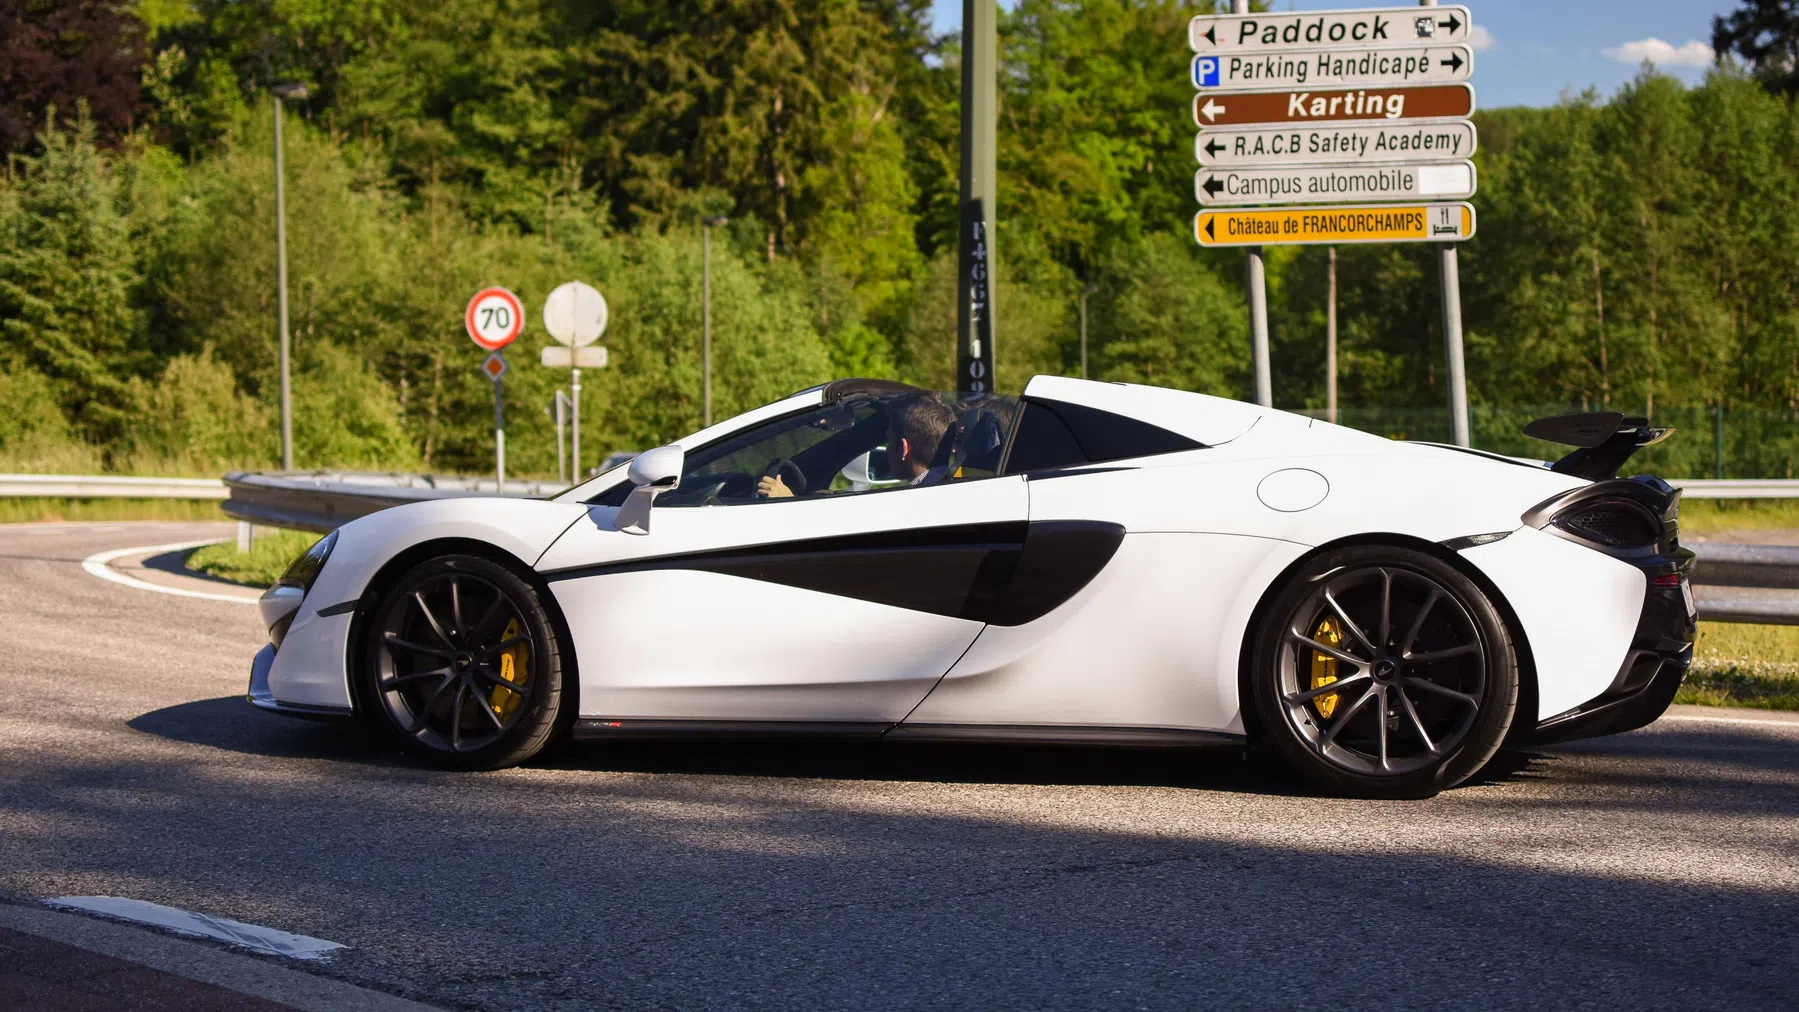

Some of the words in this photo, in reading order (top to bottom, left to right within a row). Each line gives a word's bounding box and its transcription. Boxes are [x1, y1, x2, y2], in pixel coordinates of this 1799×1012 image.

[1238, 15, 1389, 45] Paddock
[1199, 60, 1216, 84] P
[1229, 56, 1308, 83] Parking
[1317, 49, 1429, 80] Handicapé
[1287, 91, 1405, 119] Karting
[1234, 134, 1301, 156] R.A.C.B
[1308, 132, 1369, 157] Safety
[1375, 130, 1462, 154] Academy
[1227, 173, 1302, 198] Campus
[1308, 169, 1413, 194] automobile
[1228, 217, 1279, 236] Château
[1283, 216, 1299, 234] de
[1303, 213, 1423, 233] FRANCORCHAMPS
[481, 307, 509, 330] 70
